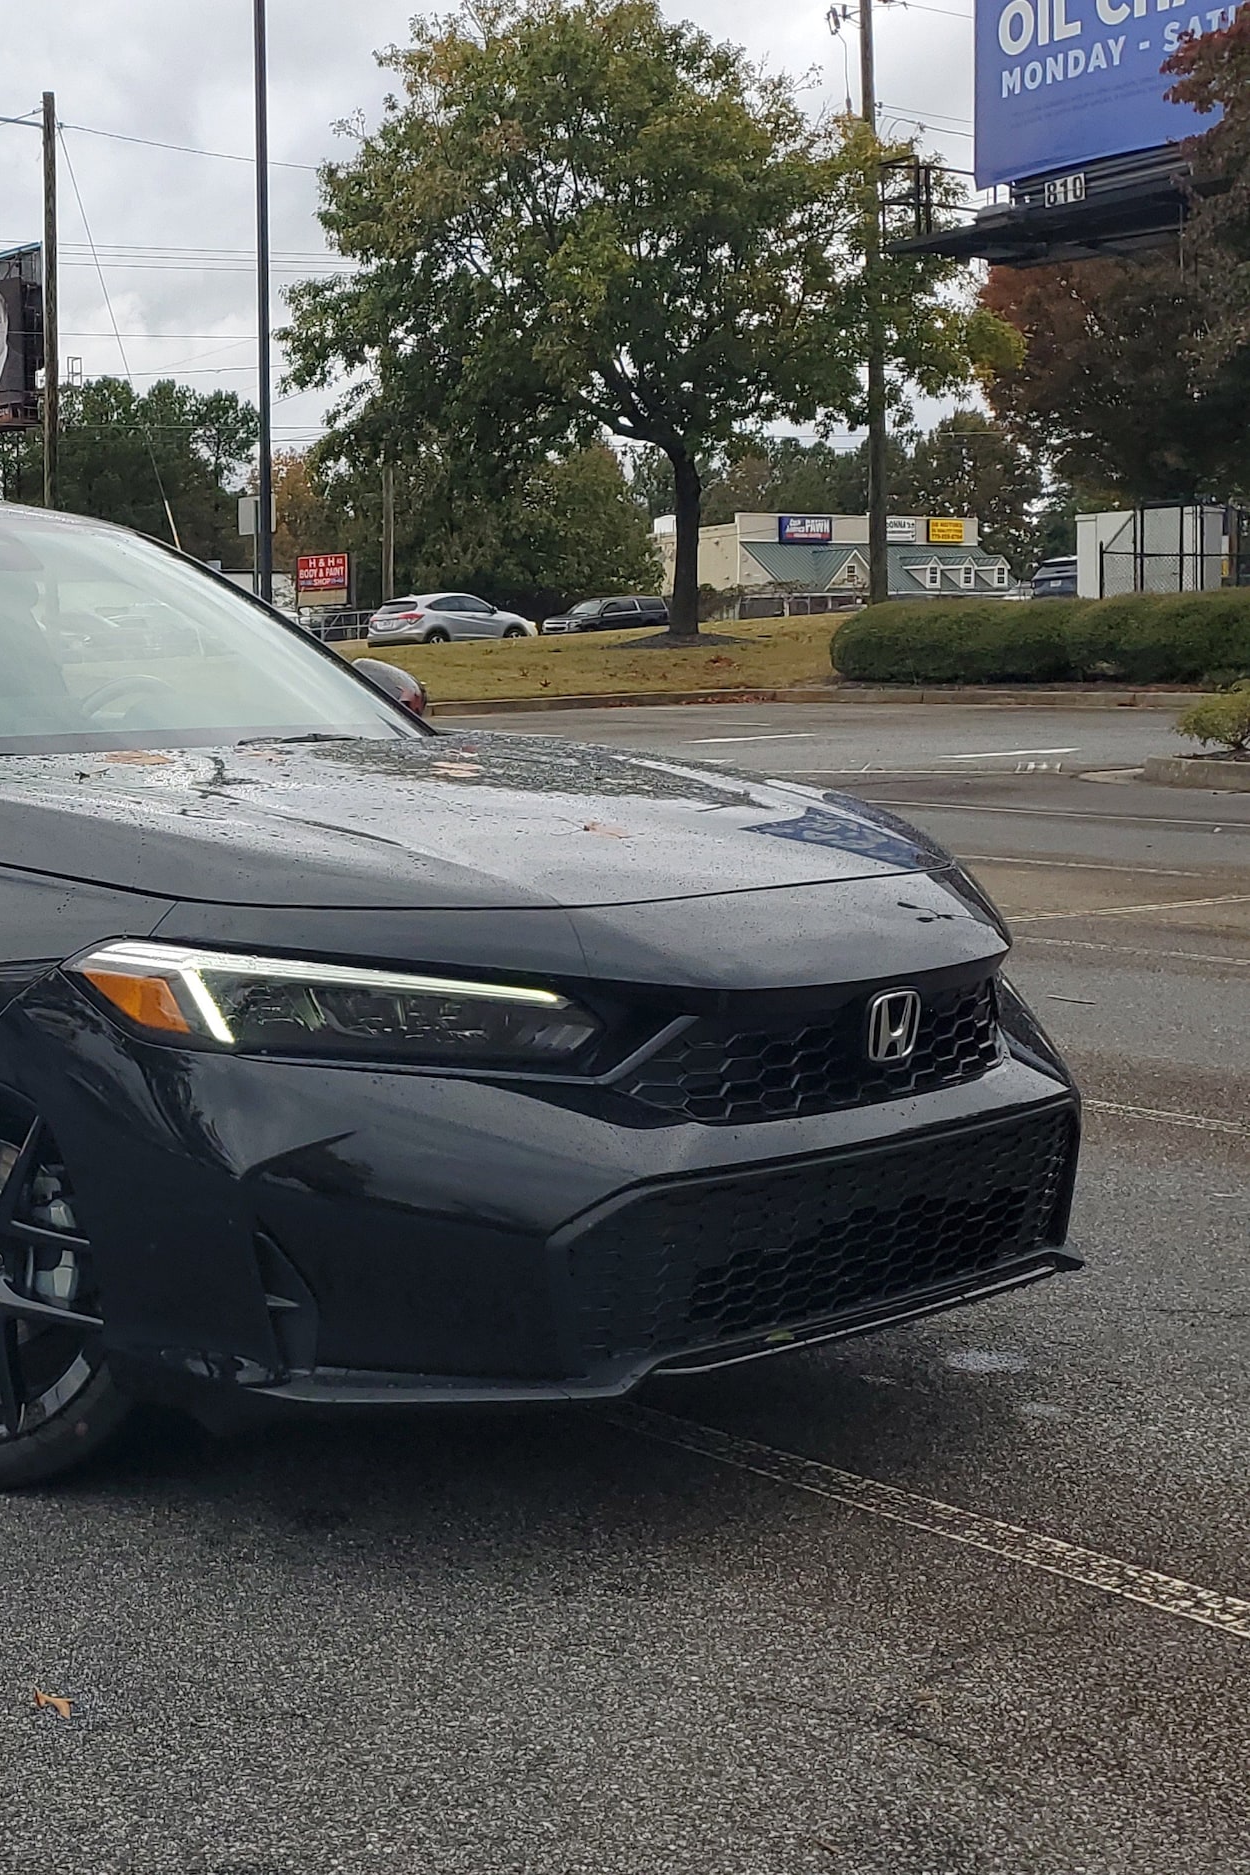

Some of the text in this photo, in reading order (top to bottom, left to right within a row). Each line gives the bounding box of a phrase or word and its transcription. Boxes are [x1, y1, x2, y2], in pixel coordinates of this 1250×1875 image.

[998, 0, 1081, 56] OIL
[1001, 35, 1126, 98] MONDAY
[1047, 176, 1082, 205] 810
[805, 519, 830, 533] PAWN
[309, 559, 316, 568] H
[327, 557, 335, 567] H
[299, 568, 318, 579] BODY
[325, 566, 344, 577] PAINT
[313, 578, 330, 586] SHOP
